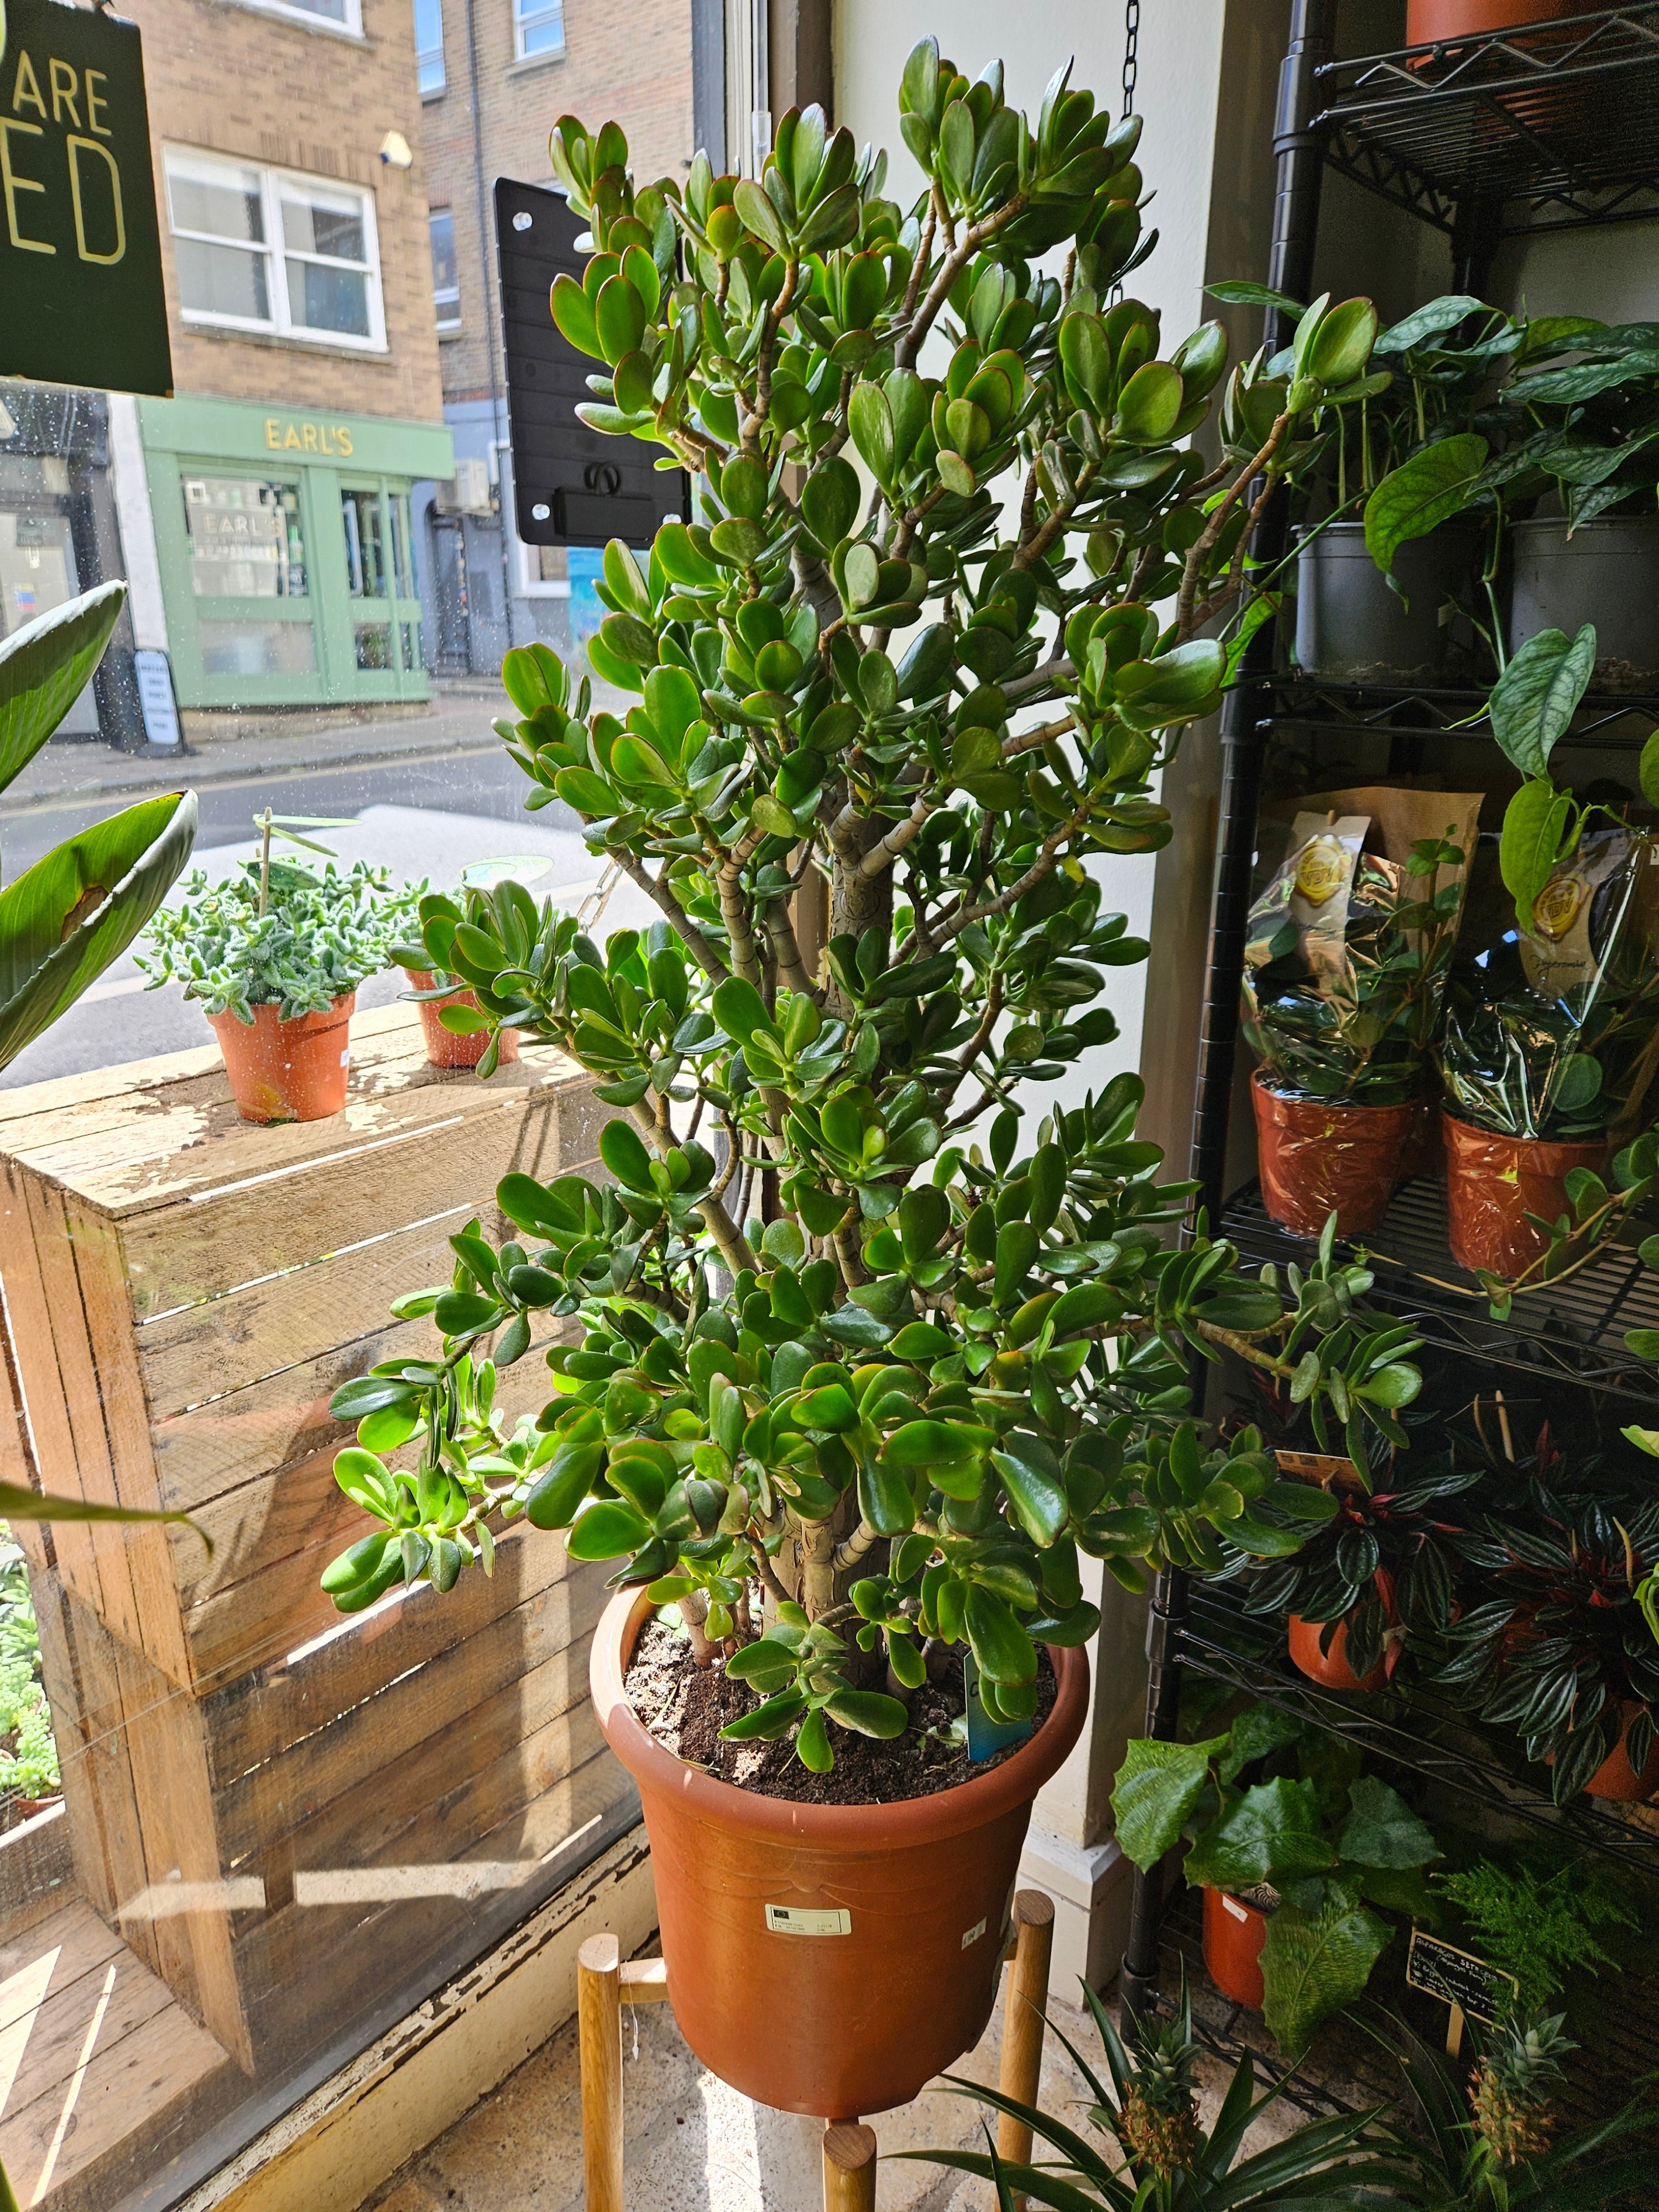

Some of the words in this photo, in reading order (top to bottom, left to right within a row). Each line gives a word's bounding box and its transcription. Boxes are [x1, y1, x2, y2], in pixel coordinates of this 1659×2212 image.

[13, 50, 112, 135] ARE
[265, 418, 353, 457] EARL'S
[203, 513, 283, 536] EARL'S
